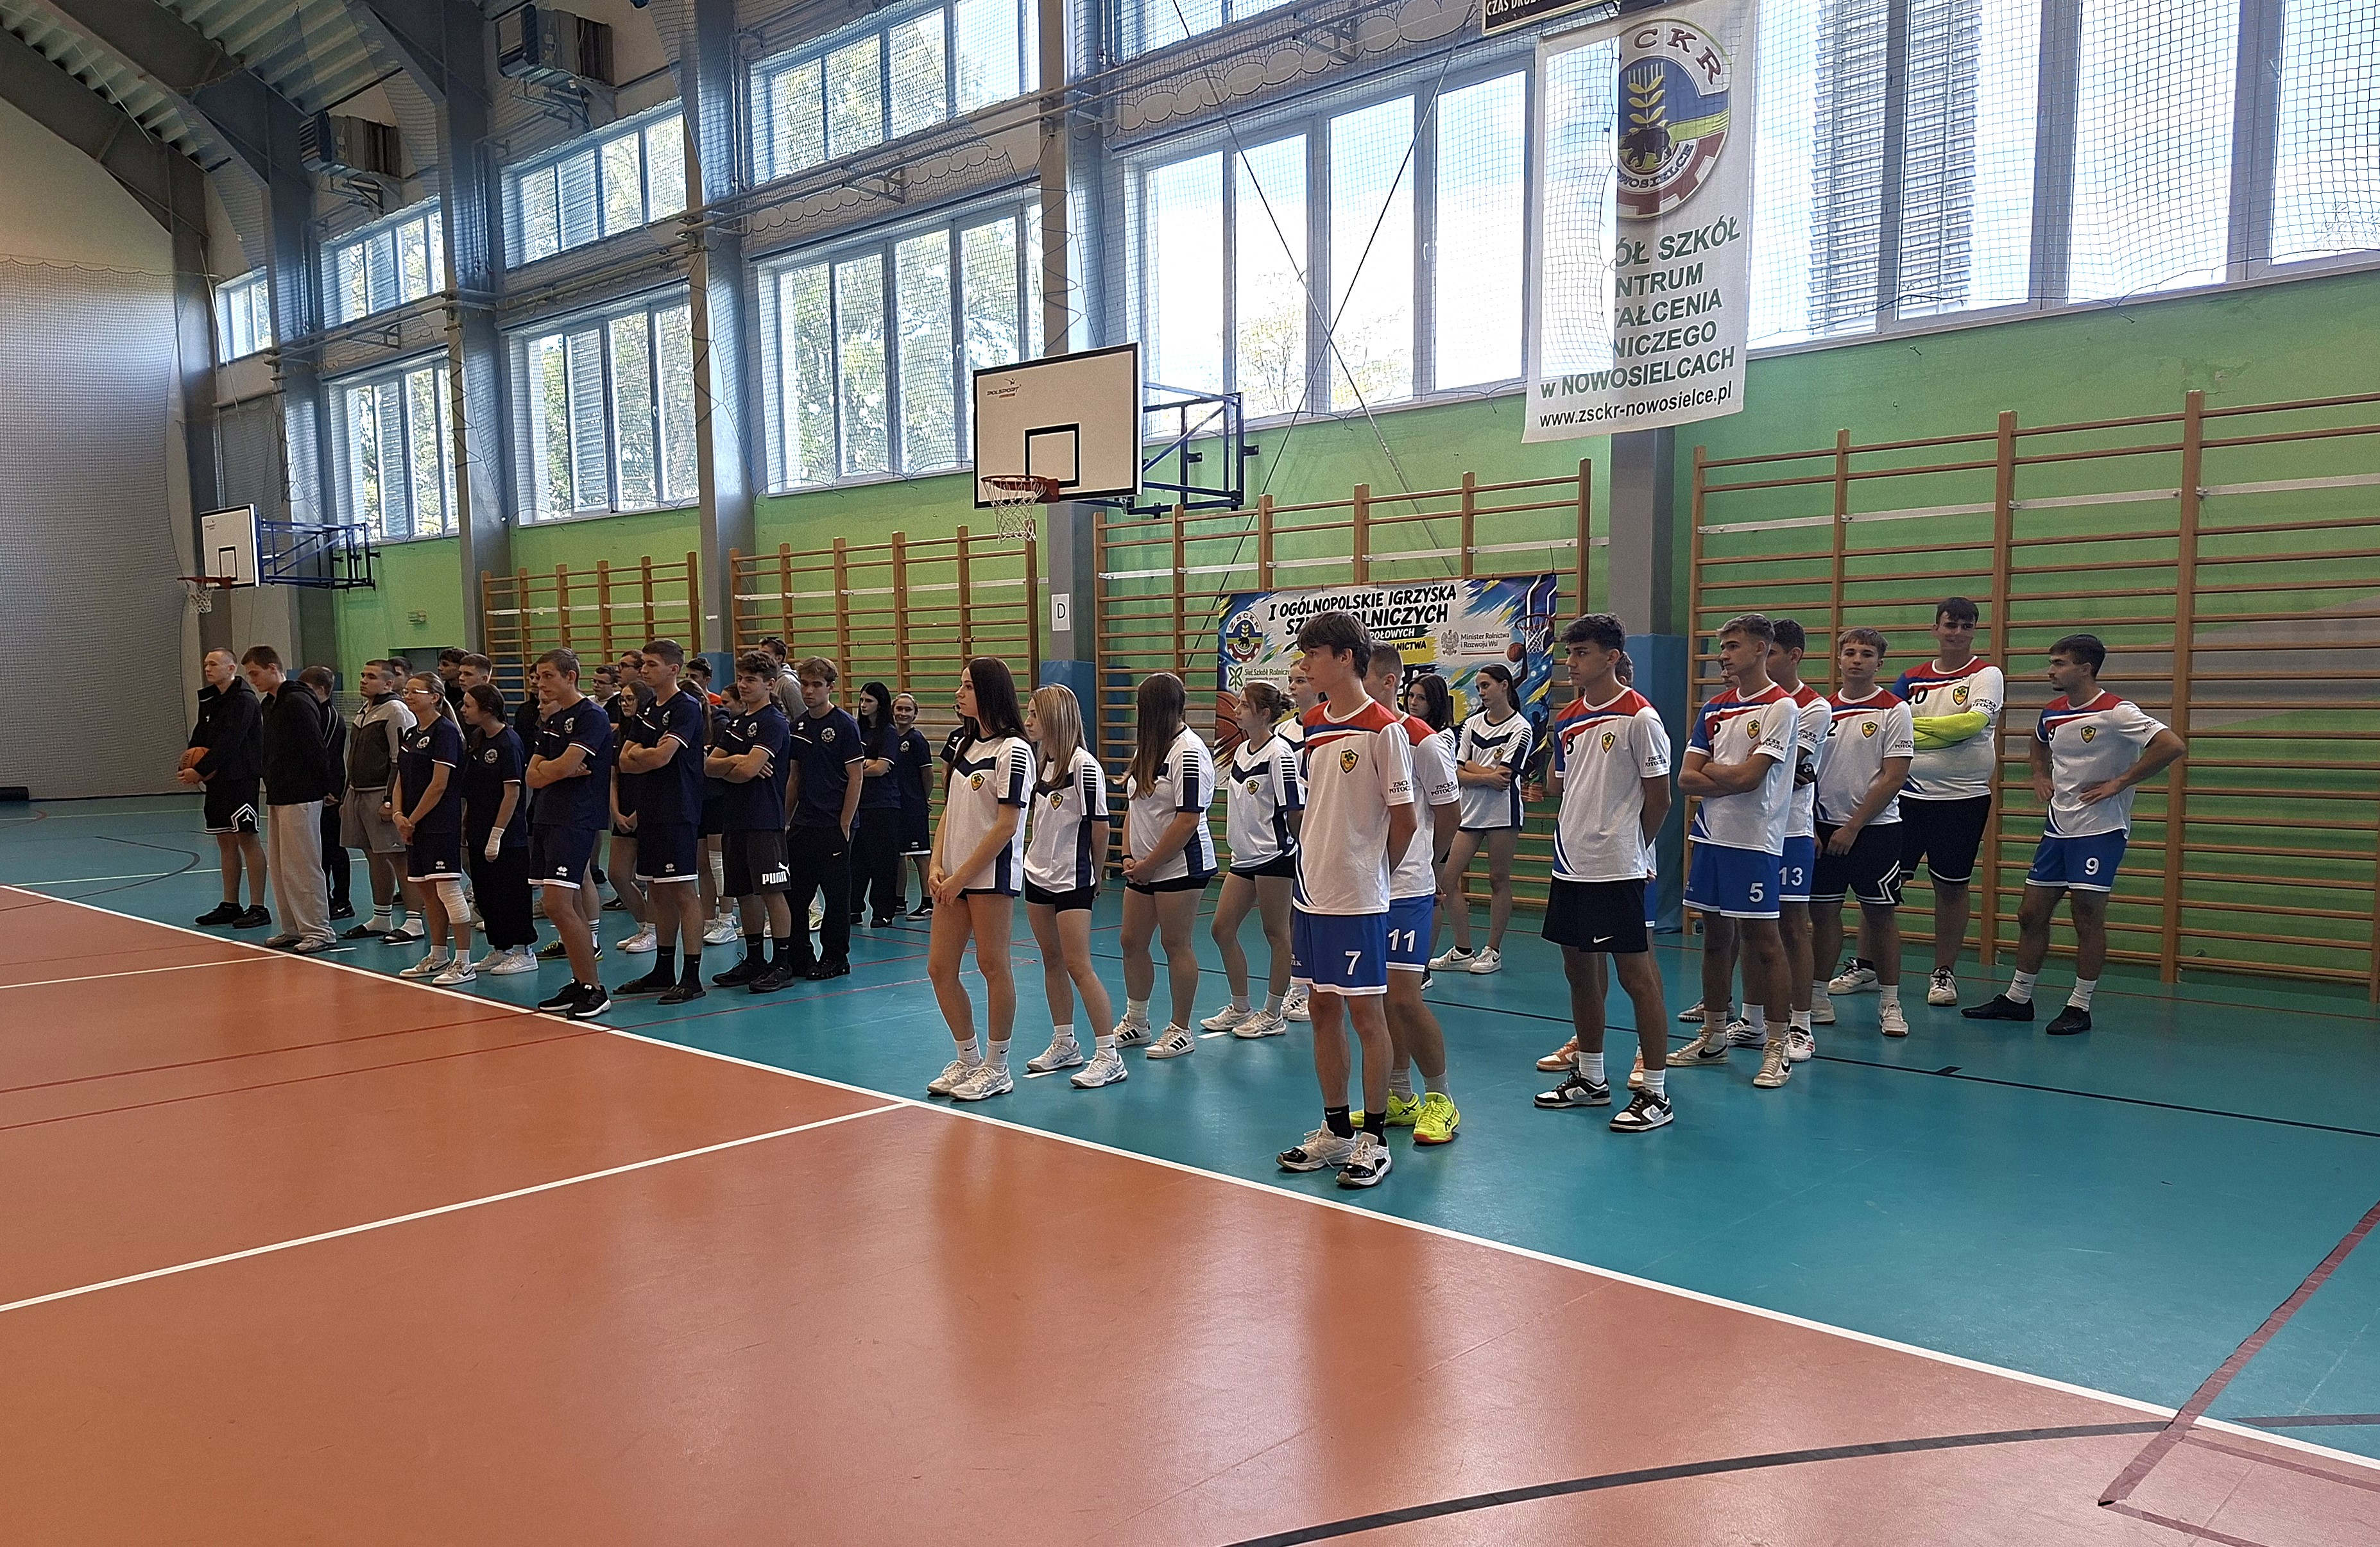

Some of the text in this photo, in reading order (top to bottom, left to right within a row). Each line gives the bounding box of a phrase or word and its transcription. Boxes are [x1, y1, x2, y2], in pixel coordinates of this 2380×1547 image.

[1487, 0, 1509, 16] CZAS
[1634, 28, 1721, 85] CKR
[1616, 215, 1740, 267] ÓŁ SZKÓŁ
[1616, 262, 1704, 298] NTRUM
[1614, 288, 1723, 328] AŁCENIA
[1614, 320, 1717, 358] NICZEGO
[1562, 345, 1735, 395] NOWOSIELCACH
[1540, 380, 1732, 427] www.zsckr-nowosielce.pl
[1057, 603, 1065, 619] D
[1280, 592, 1384, 617] OGÓLNOPOLSKIE
[1388, 585, 1456, 606] IGRZYSKA
[1285, 603, 1448, 635] SZ LNICZYCH
[1370, 628, 1415, 640] POŁOWYCH
[1392, 640, 1426, 651] NICTWA
[1464, 640, 1487, 649] Rozwoju
[1779, 867, 1802, 885] 13
[2085, 857, 2099, 875] 9
[762, 871, 787, 885] PUMA
[1749, 883, 1763, 902] 5
[1388, 929, 1415, 952] 11
[1345, 951, 1361, 975] 7
